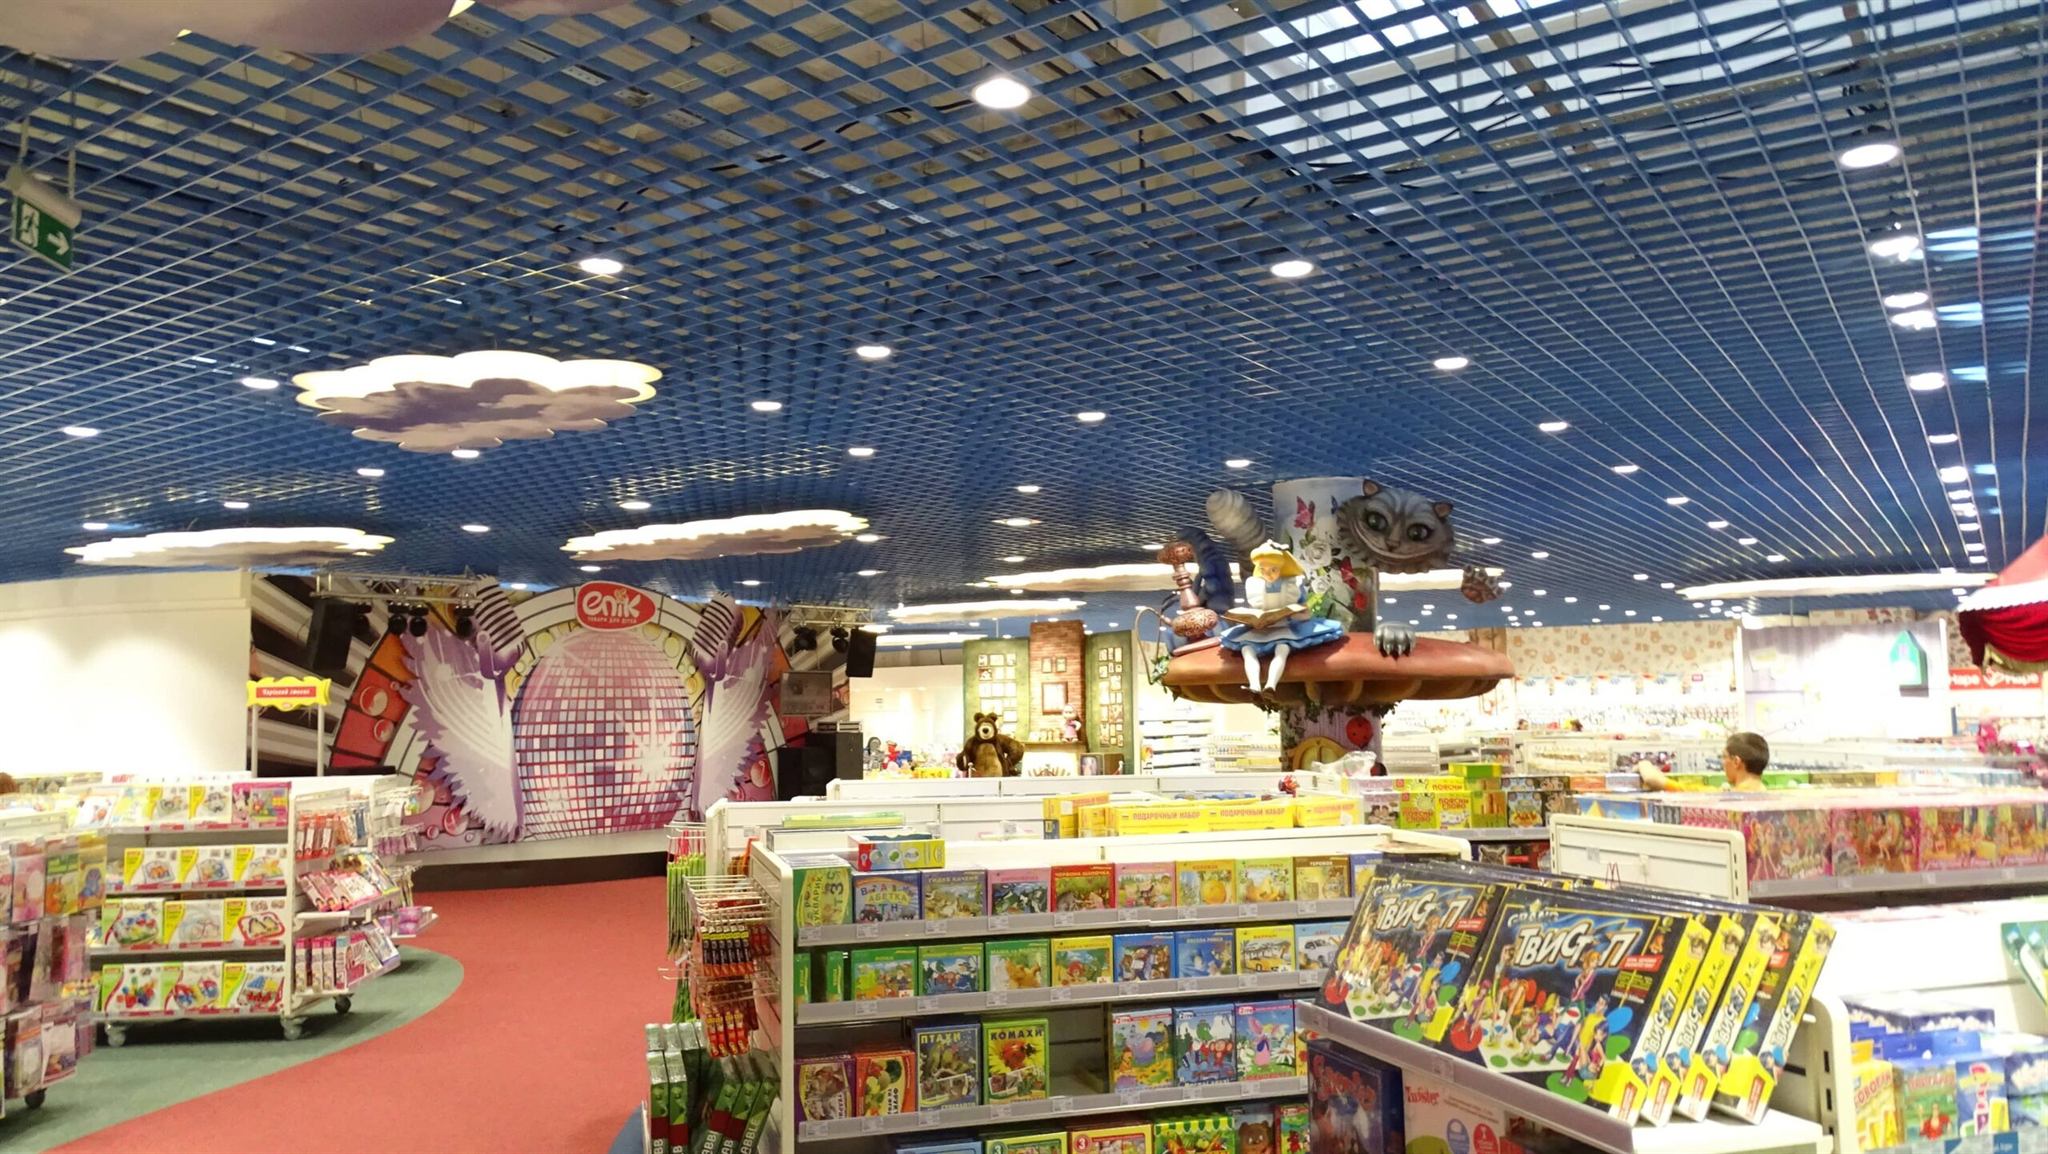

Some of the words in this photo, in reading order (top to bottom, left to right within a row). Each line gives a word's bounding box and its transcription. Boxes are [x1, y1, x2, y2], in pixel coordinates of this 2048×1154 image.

[1132, 812, 1178, 820] ПОДАРОЧНЫЙ
[1179, 811, 1200, 819] НАБОР
[1219, 809, 1263, 817] ПОДАРОЧНЫЙ
[1265, 807, 1285, 815] НАБОР
[869, 891, 909, 903] АБЕТКА
[921, 1032, 960, 1044] ПТАХИ
[991, 1029, 1044, 1041] КОМАХИ
[1405, 1086, 1440, 1105] Twister
[1078, 1140, 1086, 1149] 3
